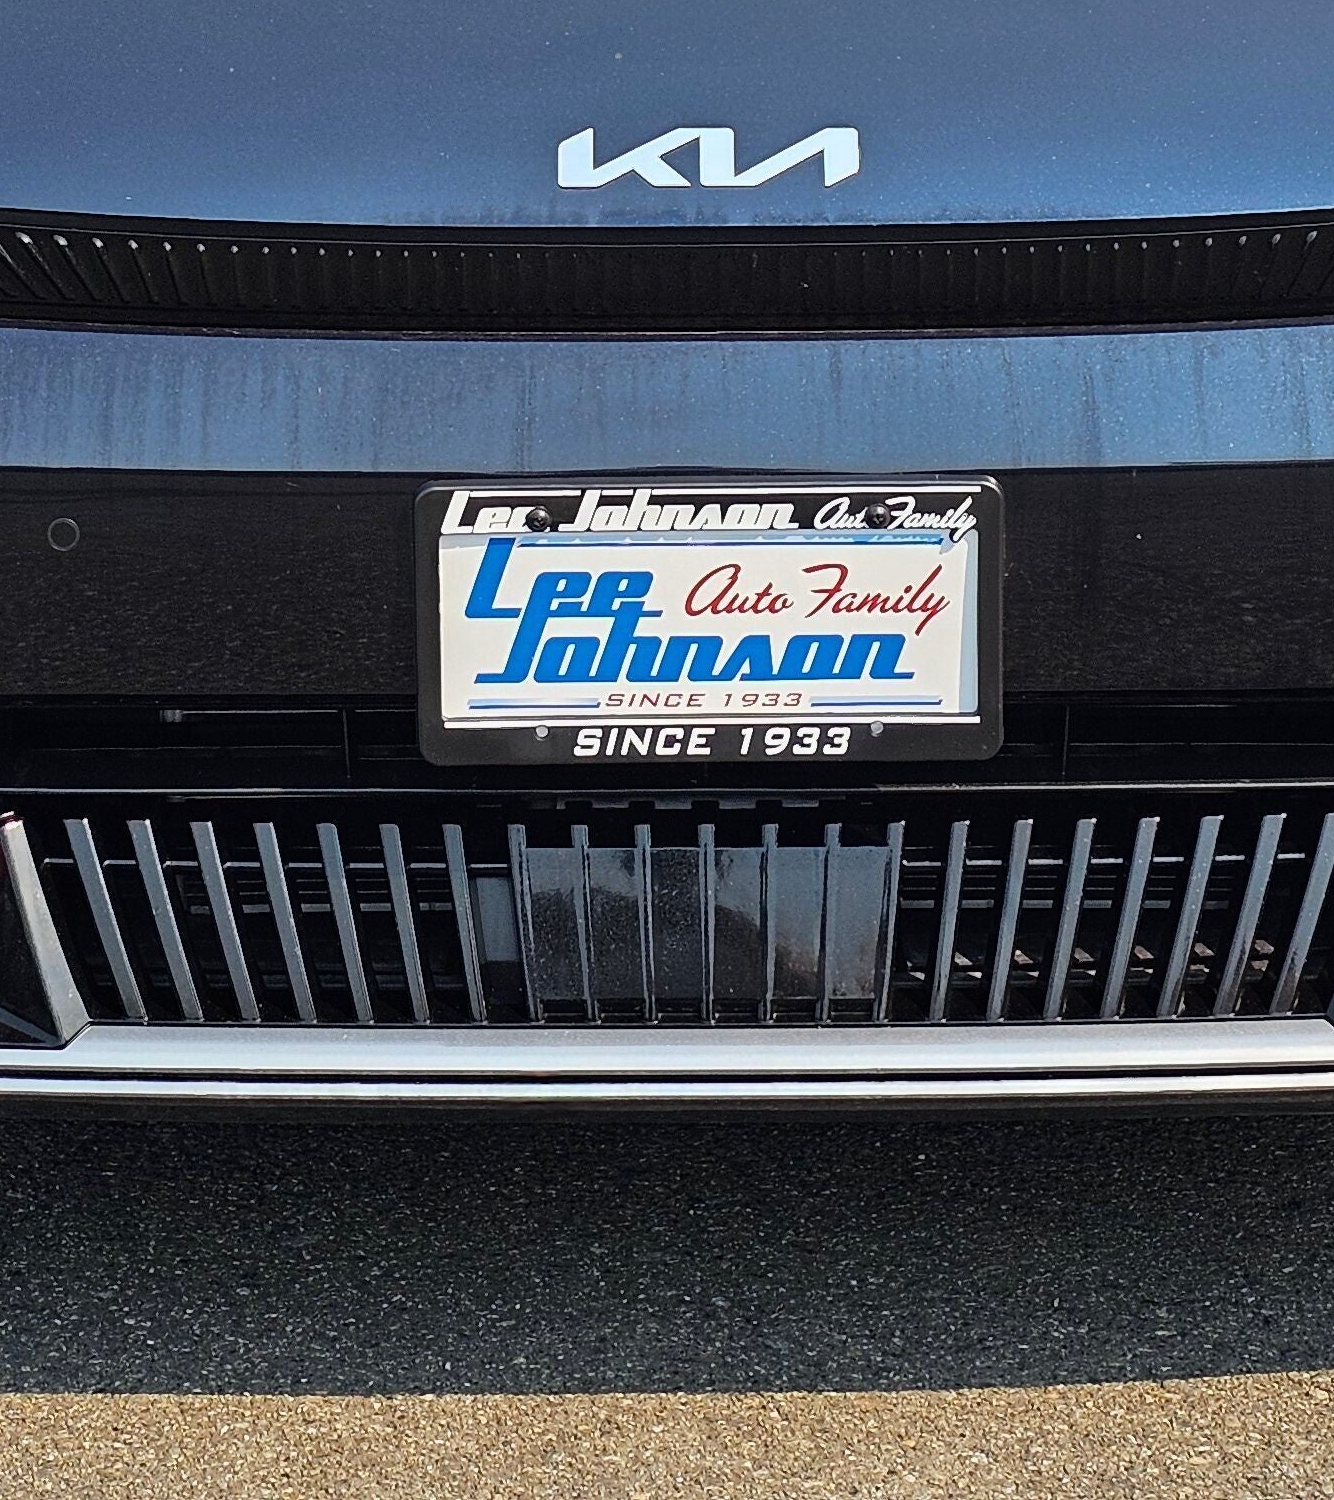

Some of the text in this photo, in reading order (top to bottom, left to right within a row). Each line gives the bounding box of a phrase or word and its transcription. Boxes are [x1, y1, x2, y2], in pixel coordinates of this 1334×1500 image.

[557, 127, 860, 188] KIA
[558, 489, 799, 532] Johnson
[814, 497, 872, 530] Aut
[885, 495, 977, 542] Family
[464, 537, 664, 618] Lee
[684, 563, 951, 636] Auto Family
[474, 610, 915, 684] Johnson
[604, 692, 803, 708] SINCE 1933
[573, 726, 851, 757] SINCE 1933
